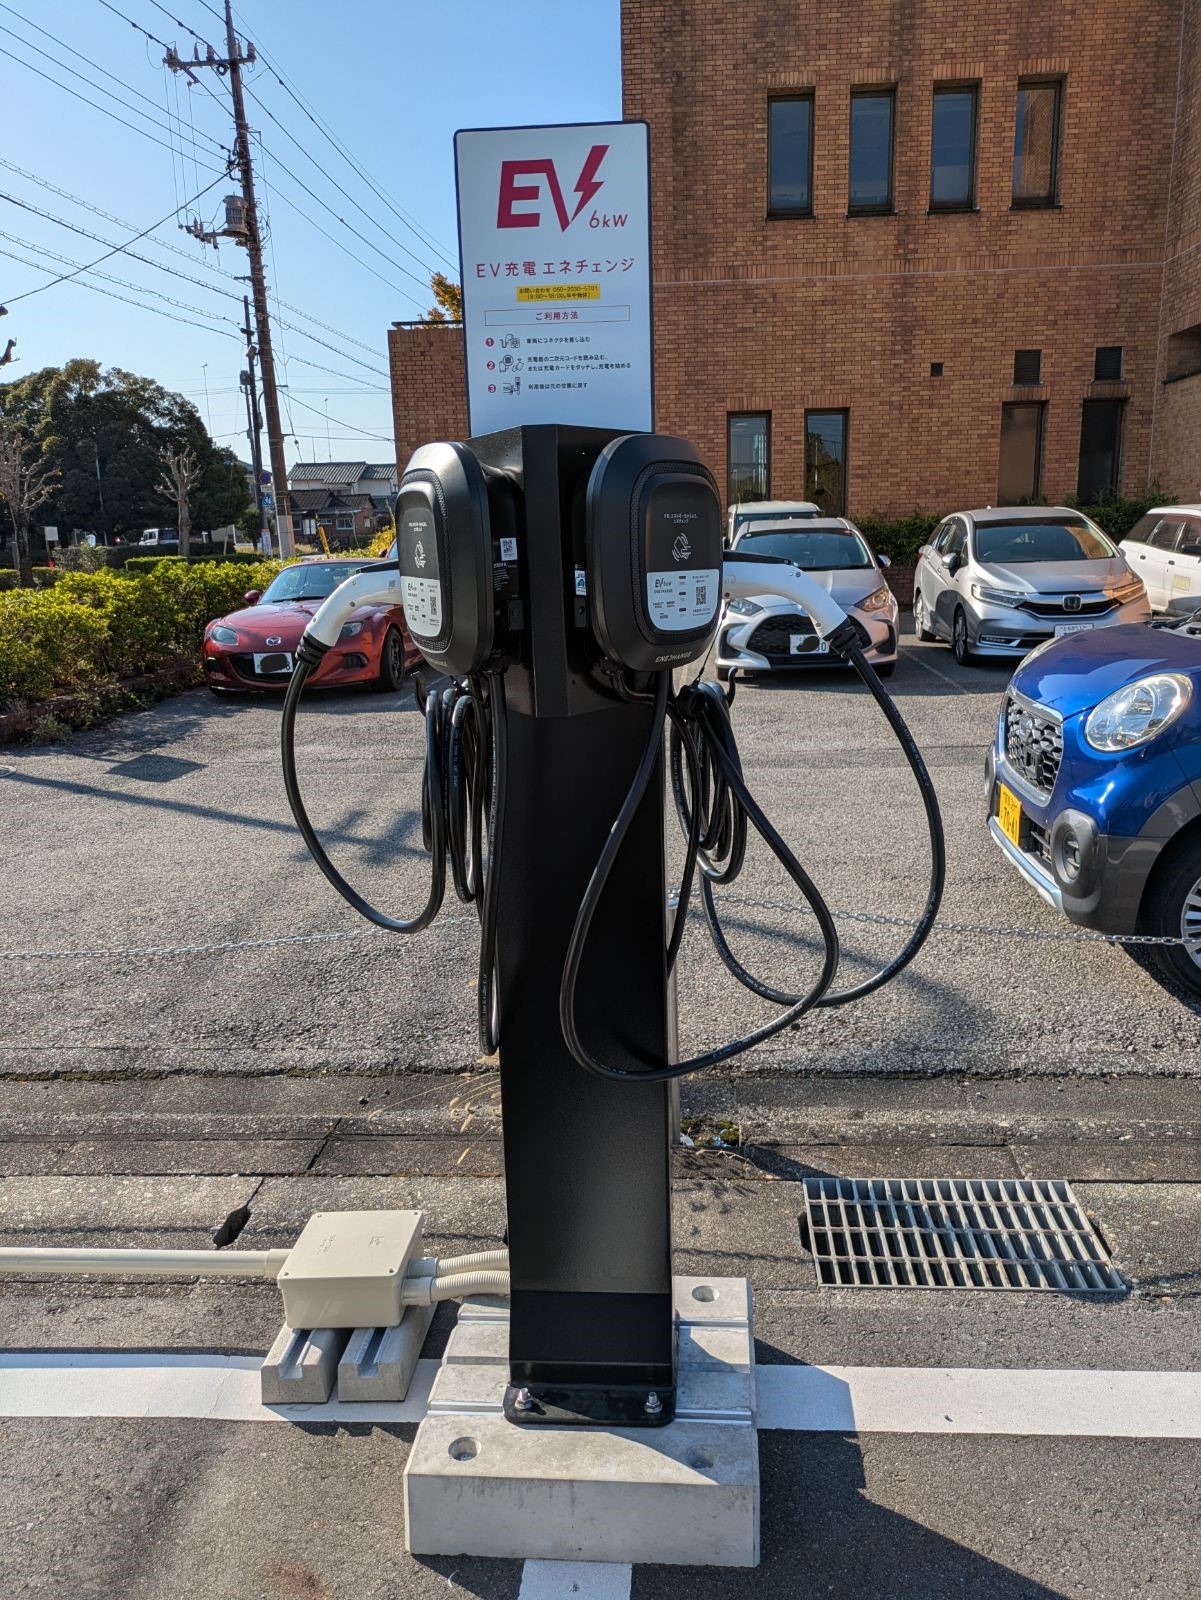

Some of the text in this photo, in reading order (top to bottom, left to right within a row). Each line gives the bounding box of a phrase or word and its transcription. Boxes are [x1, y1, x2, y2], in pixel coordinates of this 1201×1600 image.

[496, 145, 610, 233] EV
[589, 210, 628, 229] 6kW
[535, 311, 579, 321] ご利用方法
